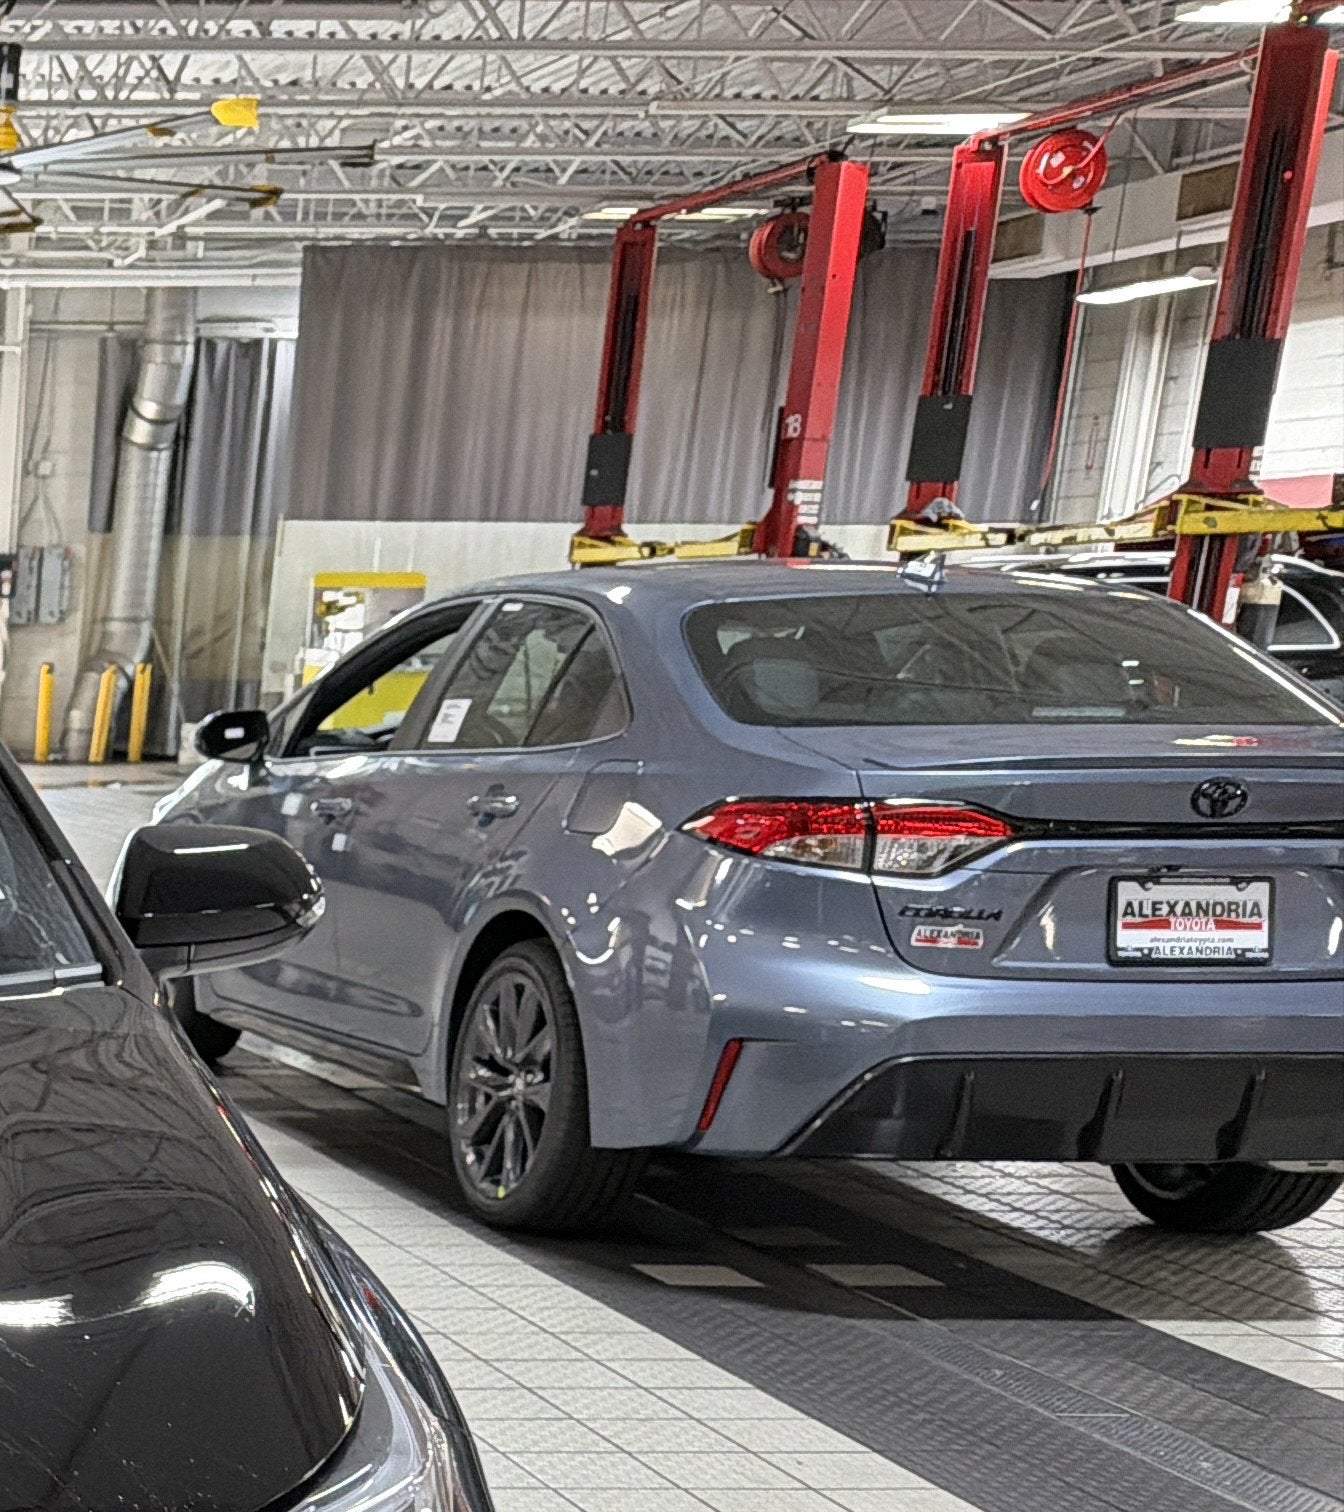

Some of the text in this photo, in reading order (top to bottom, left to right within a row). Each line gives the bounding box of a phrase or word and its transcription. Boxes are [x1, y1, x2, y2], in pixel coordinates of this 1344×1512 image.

[1122, 900, 1262, 918] ALEXANDRIA
[1169, 917, 1216, 931] TOYOTA
[1153, 946, 1234, 956] ALEXANDRIA
